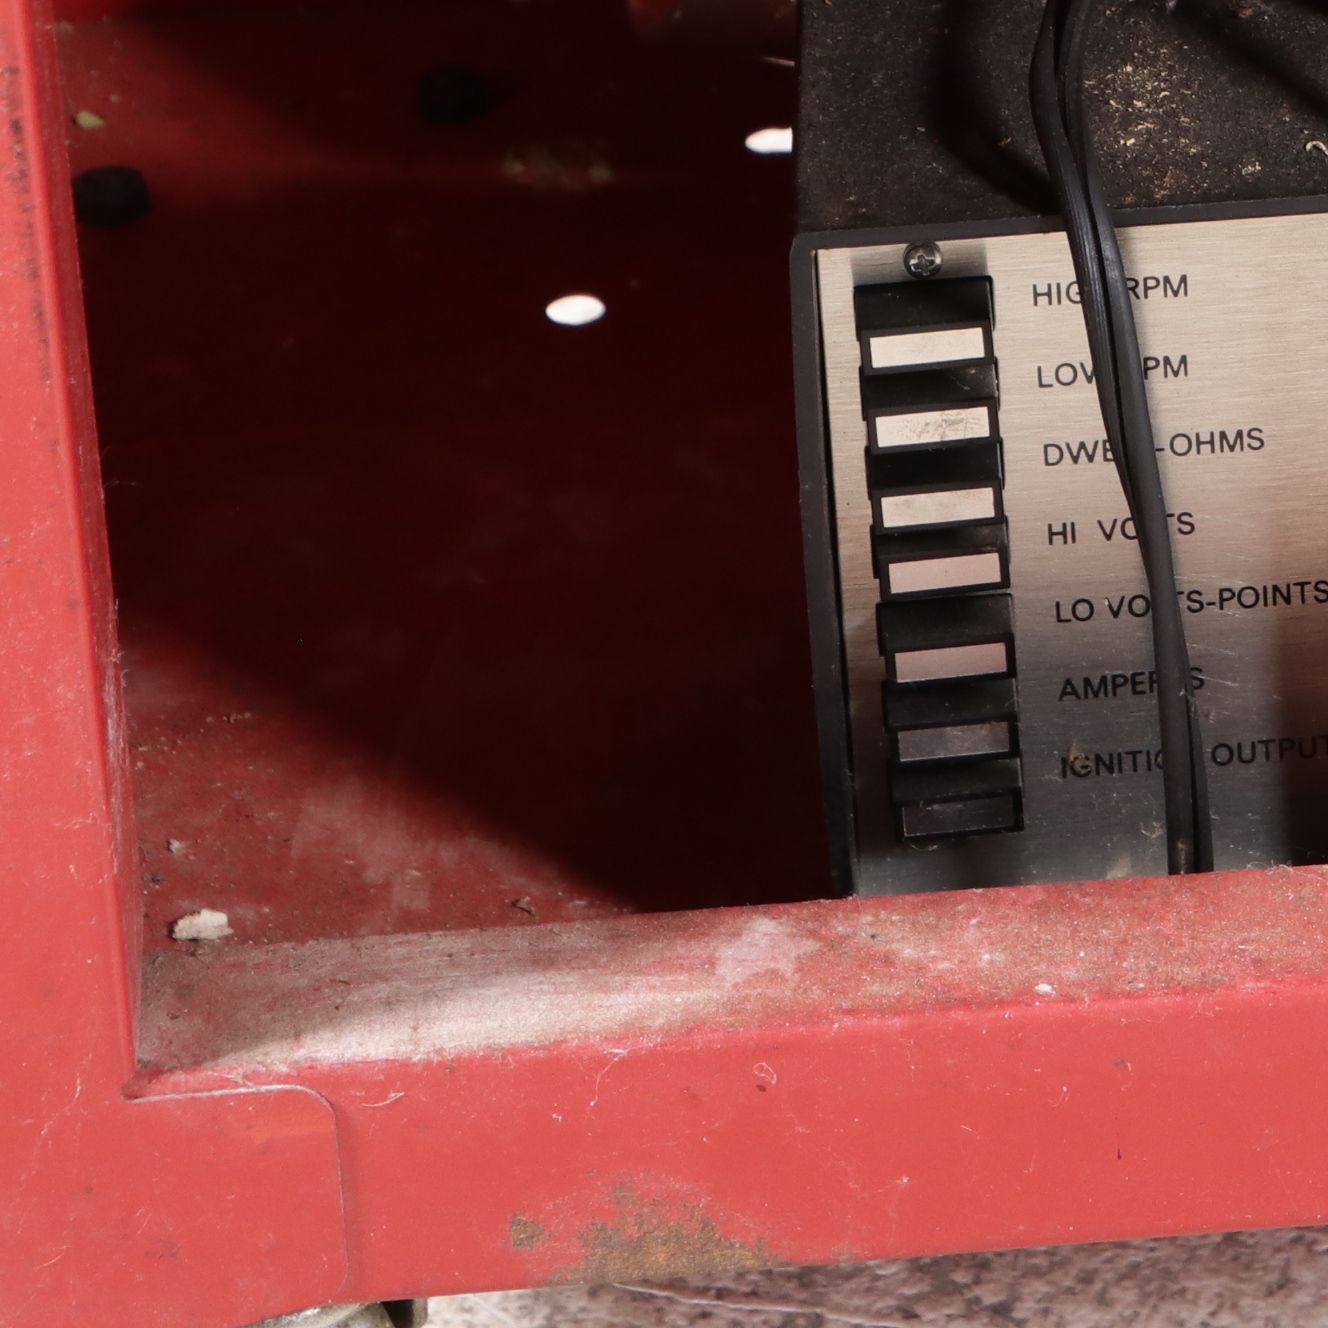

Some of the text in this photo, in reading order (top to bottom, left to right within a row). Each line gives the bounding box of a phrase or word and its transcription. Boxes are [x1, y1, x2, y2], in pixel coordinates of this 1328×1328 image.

[1032, 280, 1083, 306] HIG
[1142, 354, 1189, 381] PM
[1043, 427, 1265, 467] DWE-OHMS
[1047, 522, 1077, 546] HI
[1055, 598, 1095, 623] LO
